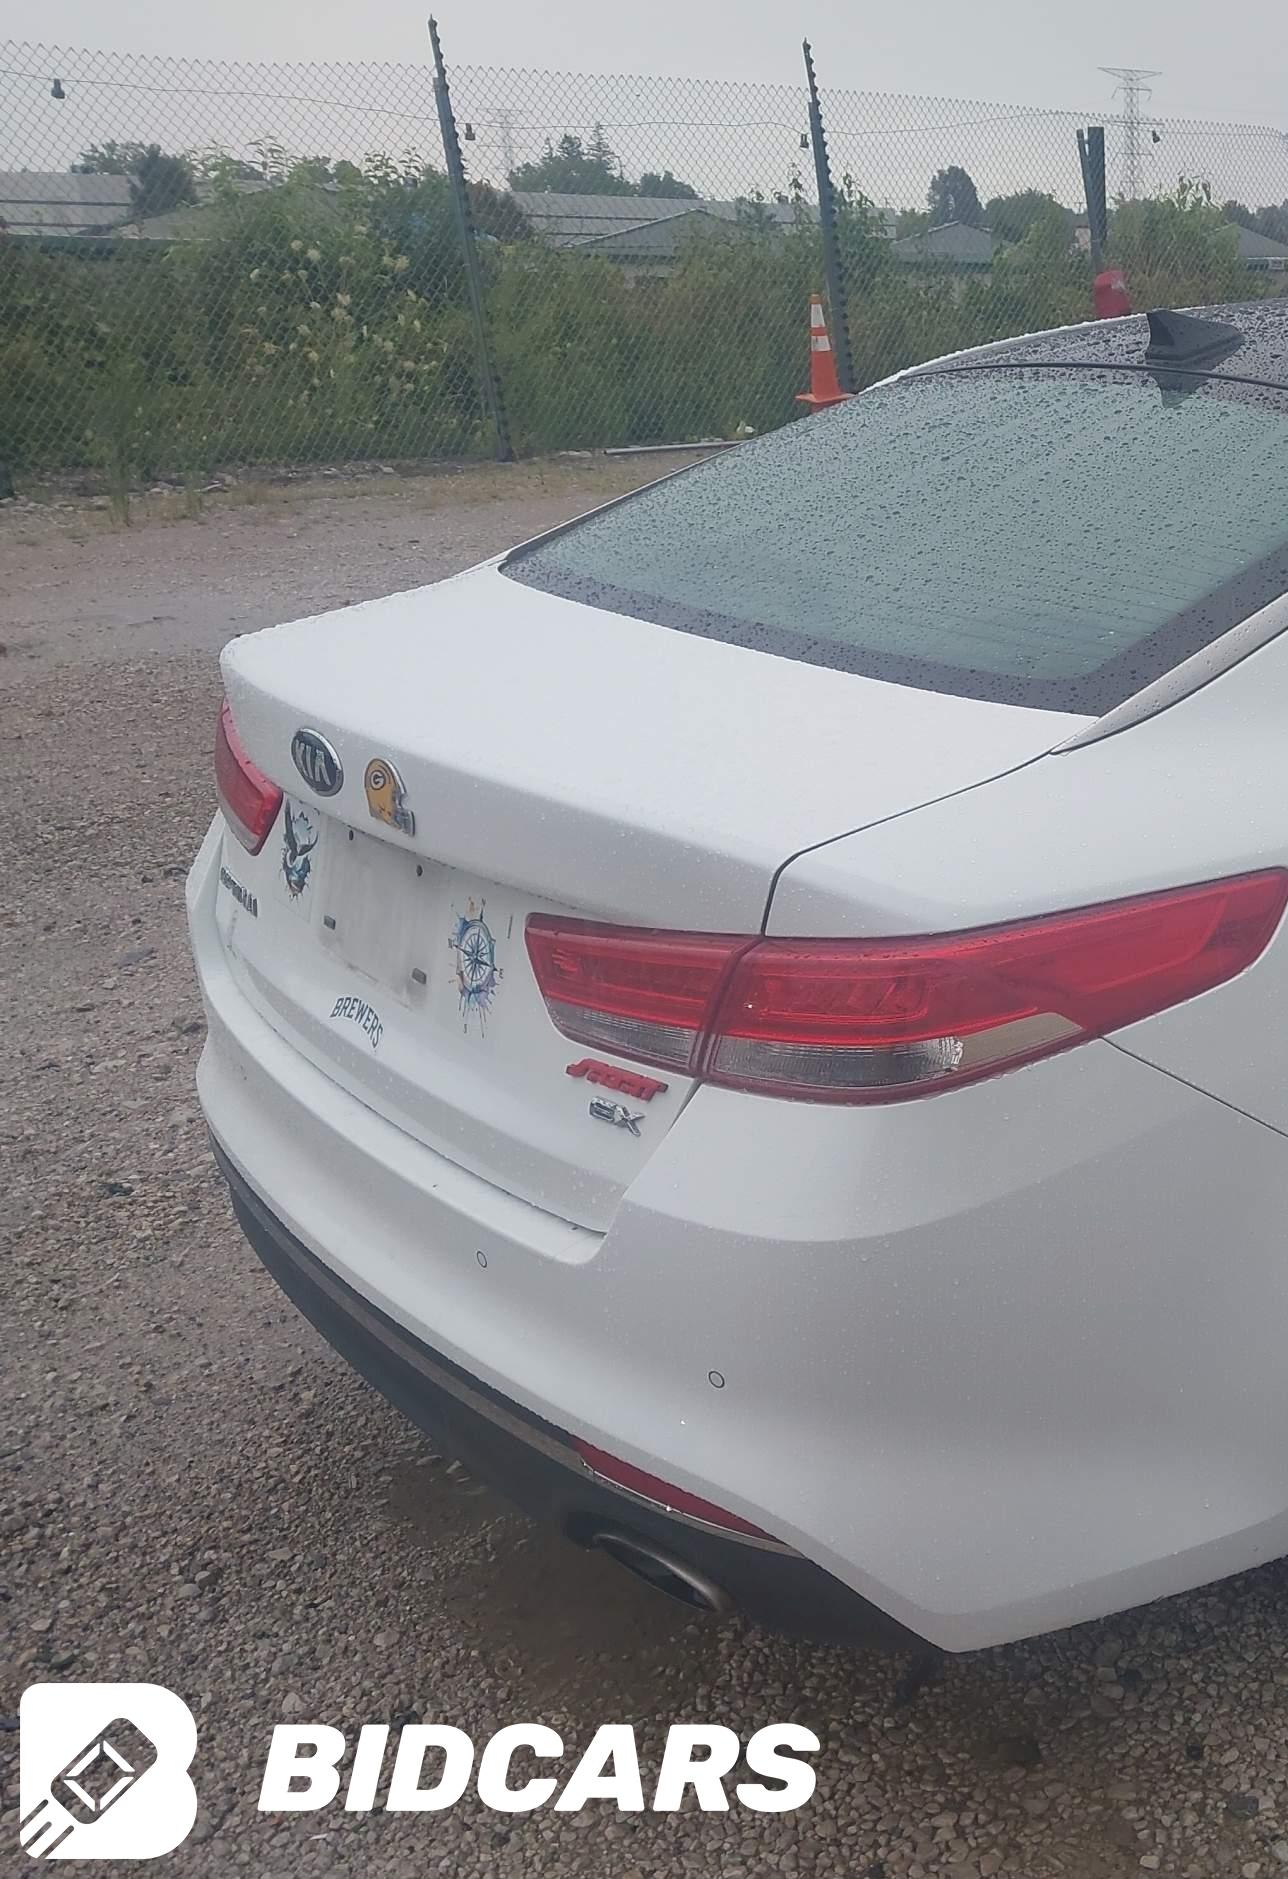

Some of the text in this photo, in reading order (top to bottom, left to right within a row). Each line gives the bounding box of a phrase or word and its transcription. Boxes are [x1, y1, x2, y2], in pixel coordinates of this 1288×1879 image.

[295, 739, 332, 786] KIA
[329, 996, 384, 1049] BREWERS
[589, 1096, 646, 1137] EX
